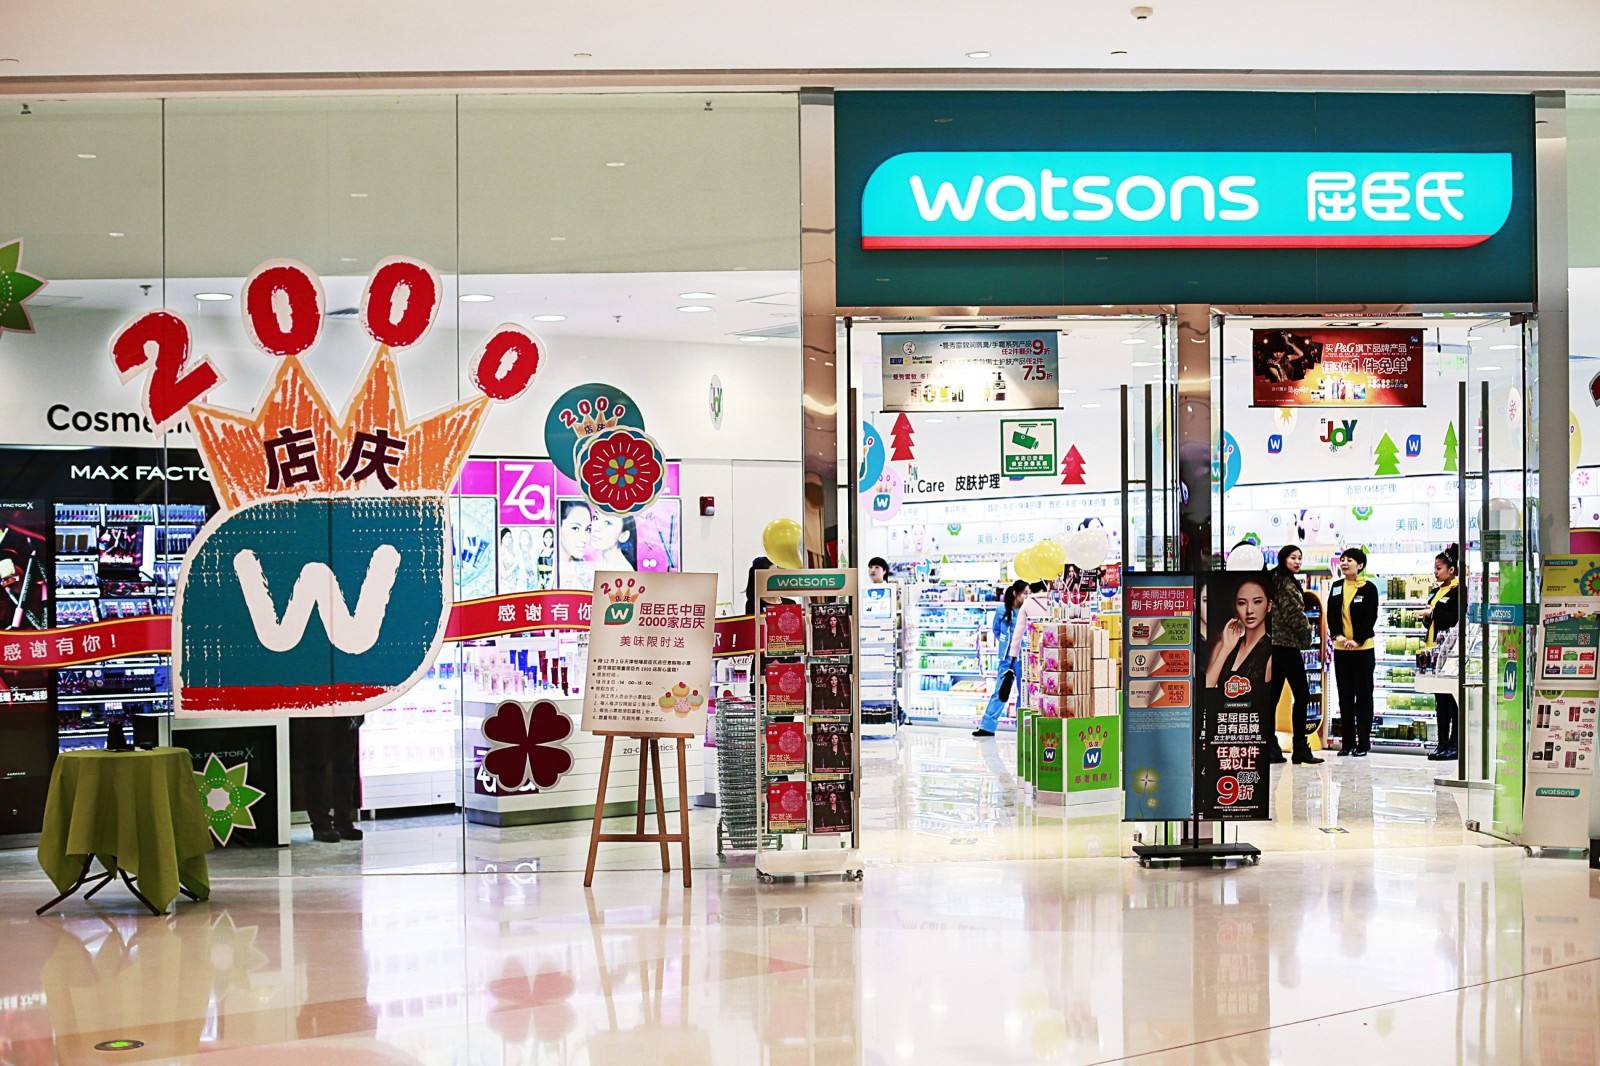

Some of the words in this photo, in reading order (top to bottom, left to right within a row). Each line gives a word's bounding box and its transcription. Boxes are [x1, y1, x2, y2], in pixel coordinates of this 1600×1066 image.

[908, 168, 1260, 222] watsons
[1306, 170, 1465, 222] 屈臣氏
[113, 262, 540, 424] 2000
[1320, 420, 1358, 447] JOY
[263, 427, 406, 491] 店庆
[70, 465, 129, 481] MAX
[917, 479, 945, 494] Care
[955, 473, 1001, 492] 皮肤护理
[502, 464, 552, 521] Za
[777, 576, 836, 588] watsons
[232, 543, 402, 654] W
[640, 603, 706, 616] 屈臣氏中国
[638, 616, 706, 630] 2000家店庆
[619, 635, 686, 649] 美味限时送
[729, 655, 753, 665] New!
[1217, 712, 1260, 724] 买屈臣氏
[1217, 723, 1260, 734] 自有品牌
[1216, 746, 1260, 758] 任意3件
[1219, 758, 1256, 770] 或以上
[1236, 771, 1261, 784] 额外
[1540, 788, 1575, 797] watsons
